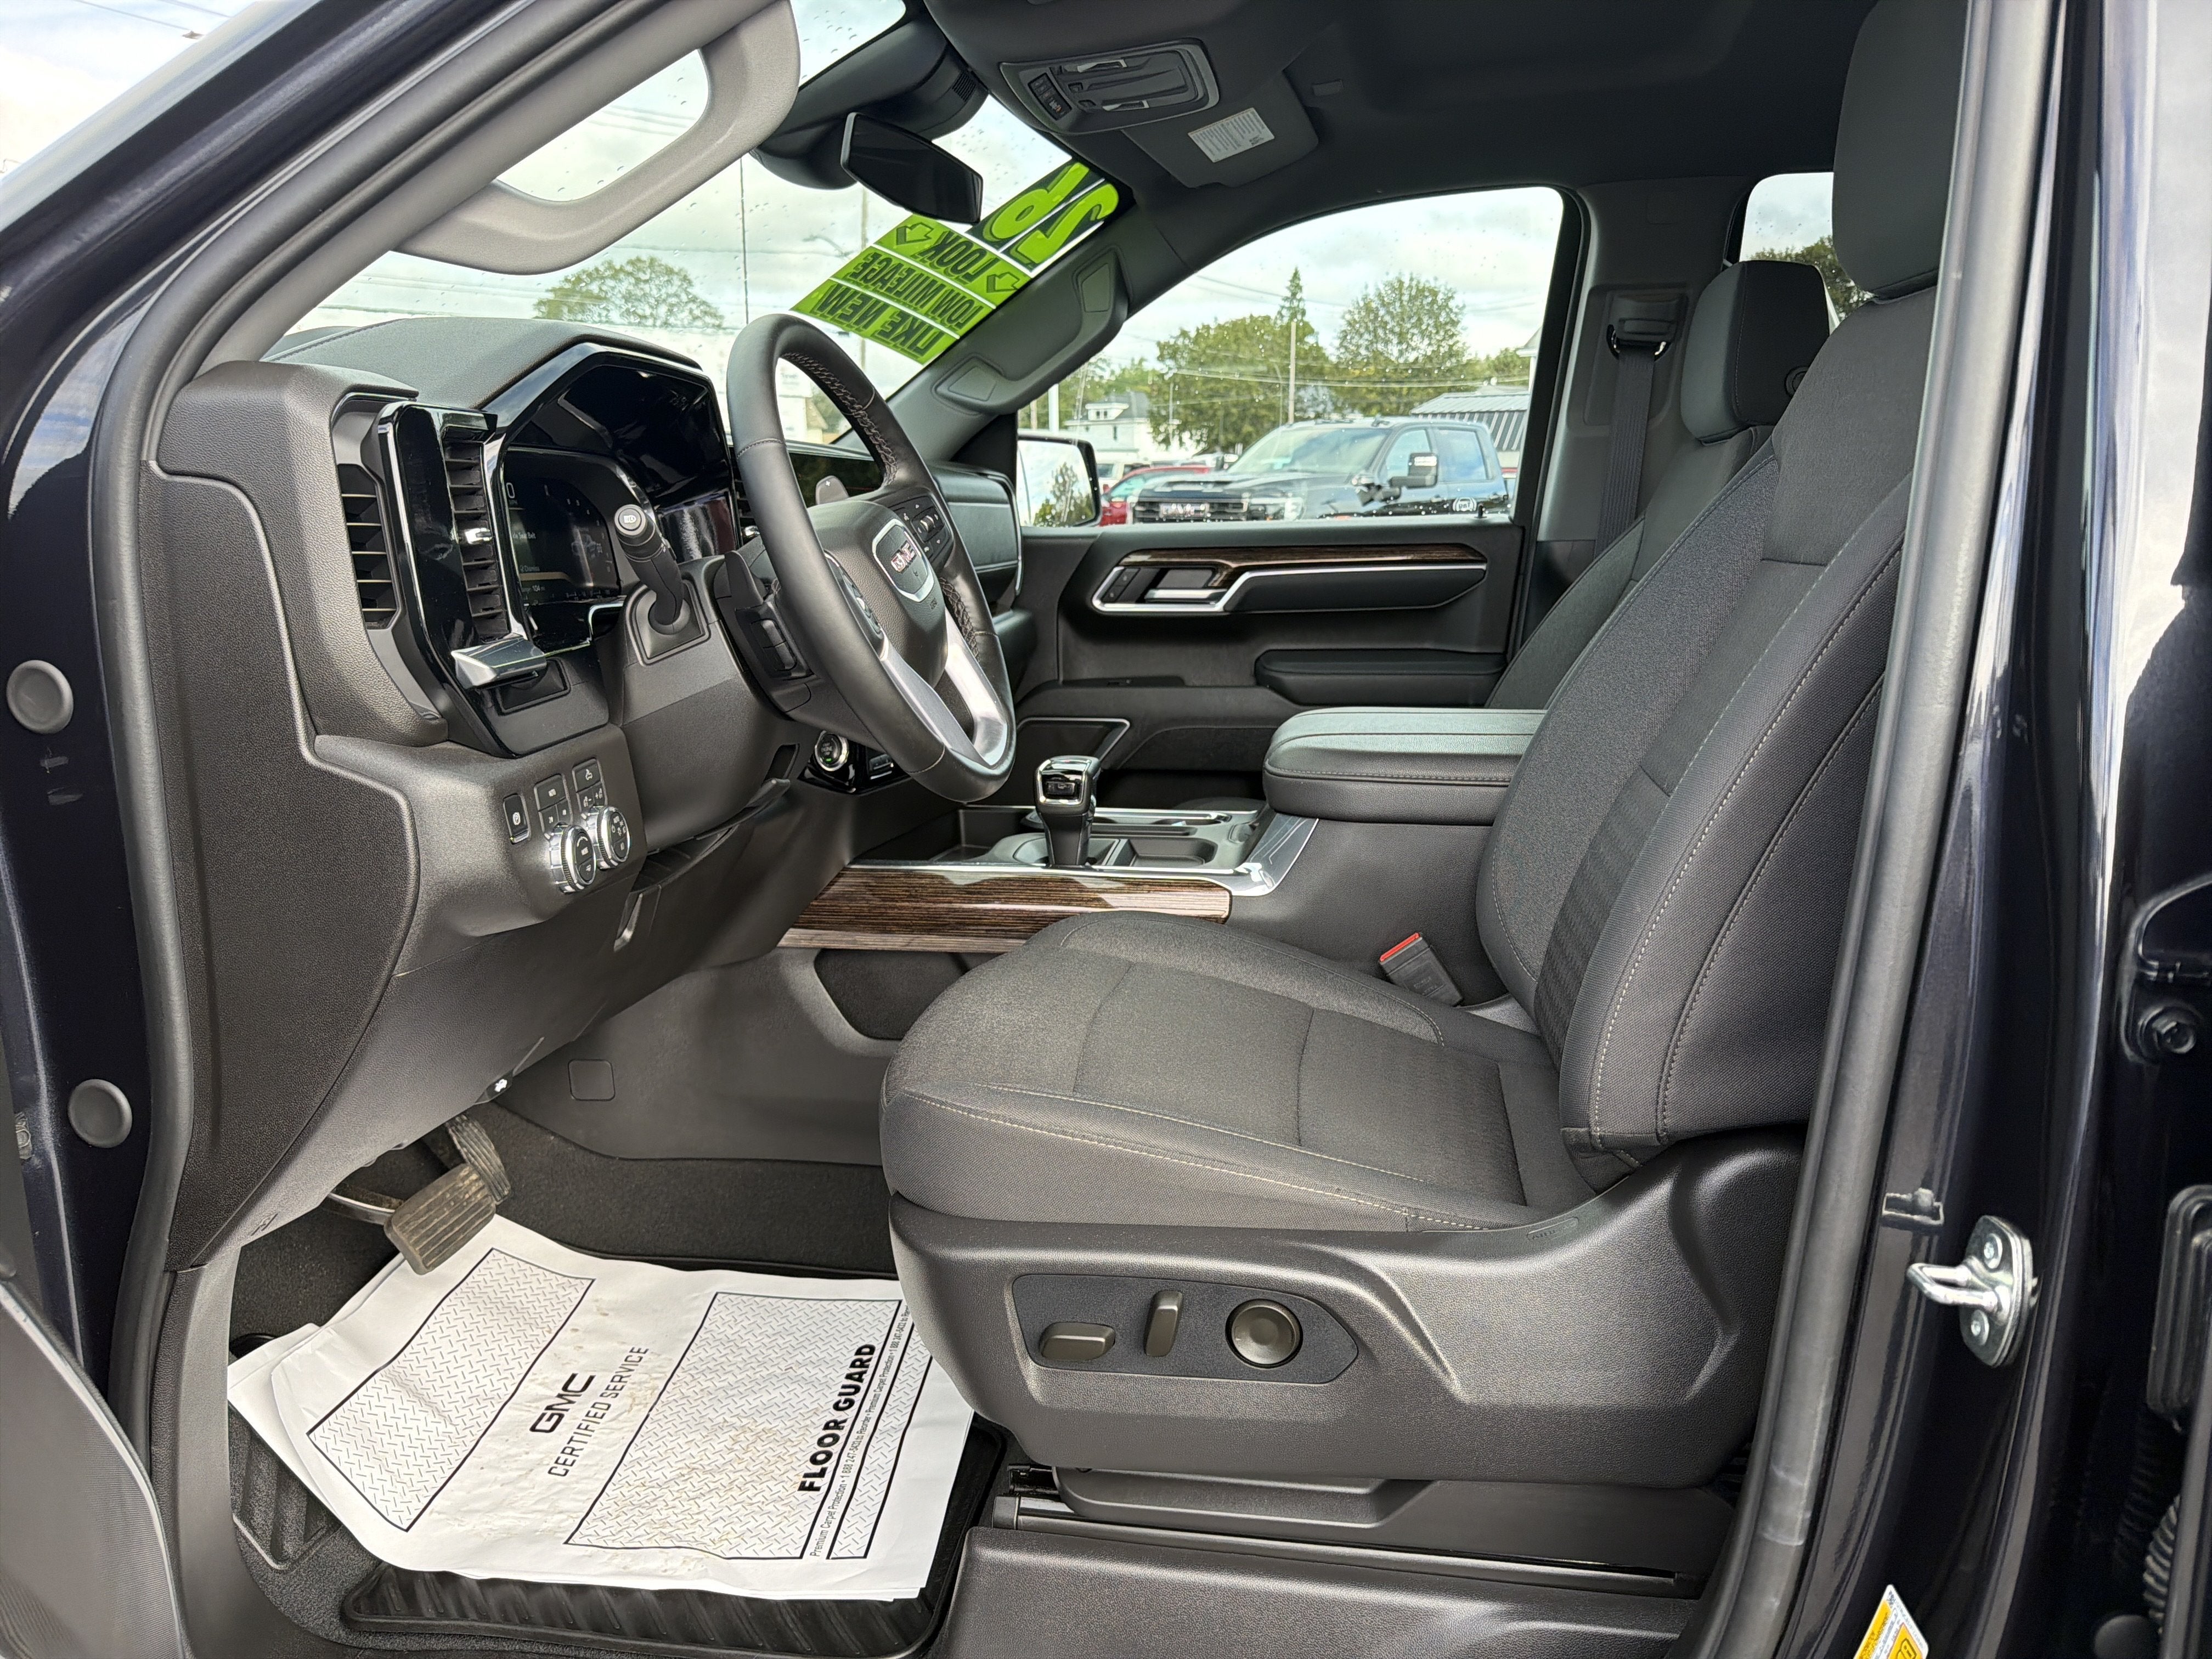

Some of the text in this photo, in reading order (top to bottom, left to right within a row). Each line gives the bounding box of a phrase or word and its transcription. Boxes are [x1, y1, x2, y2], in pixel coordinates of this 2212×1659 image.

[890, 541, 916, 572] GMC
[879, 1355, 895, 1378] Protection
[873, 1378, 887, 1392] Carpet
[529, 1372, 596, 1434] GMC
[547, 1346, 649, 1477] CERTIFIED SERVICE
[865, 1393, 881, 1413] Premium
[797, 1344, 876, 1492] FLOOR GUARD
[856, 1417, 872, 1435] Reorder
[842, 1463, 854, 1474] 888
[827, 1483, 848, 1510] Protection
[820, 1510, 837, 1529] Carpet
[809, 1529, 829, 1557] Premium
